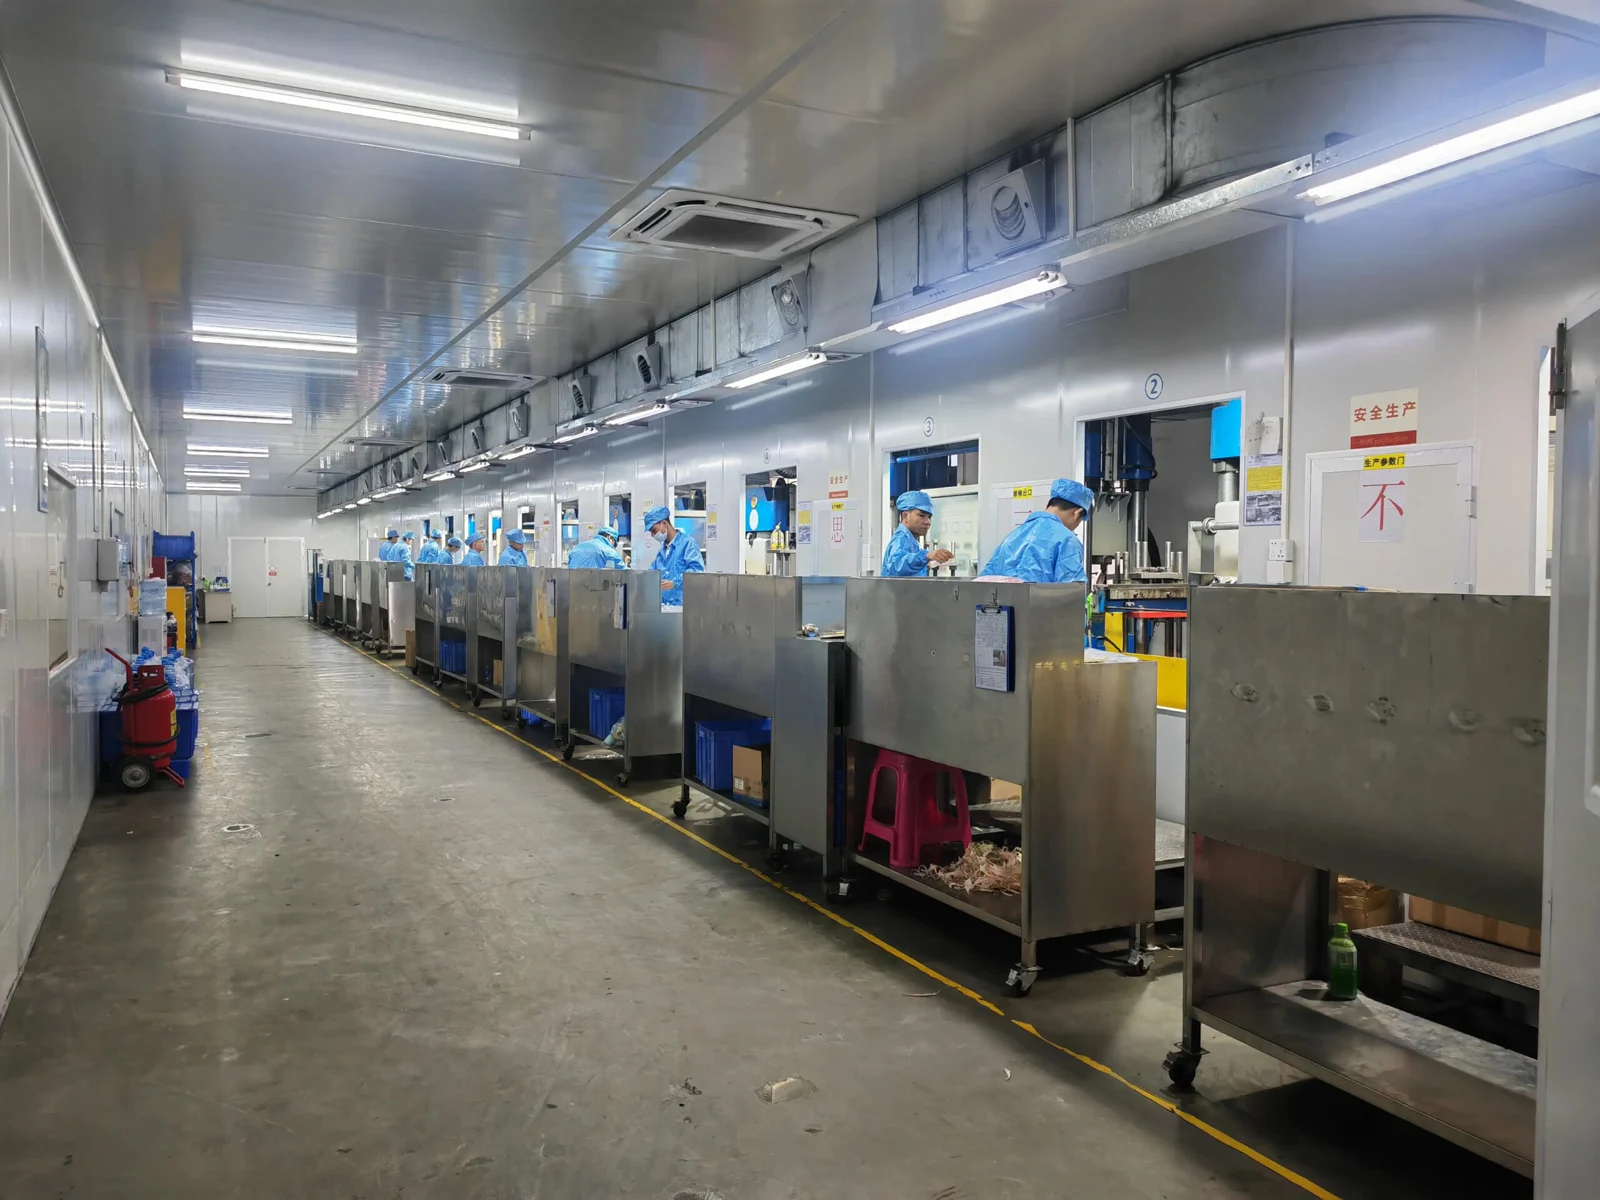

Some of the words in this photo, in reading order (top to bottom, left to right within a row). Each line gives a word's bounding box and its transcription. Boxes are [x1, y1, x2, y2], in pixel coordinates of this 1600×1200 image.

[1353, 401, 1417, 423] 安全生产
[1360, 480, 1406, 531] 不
